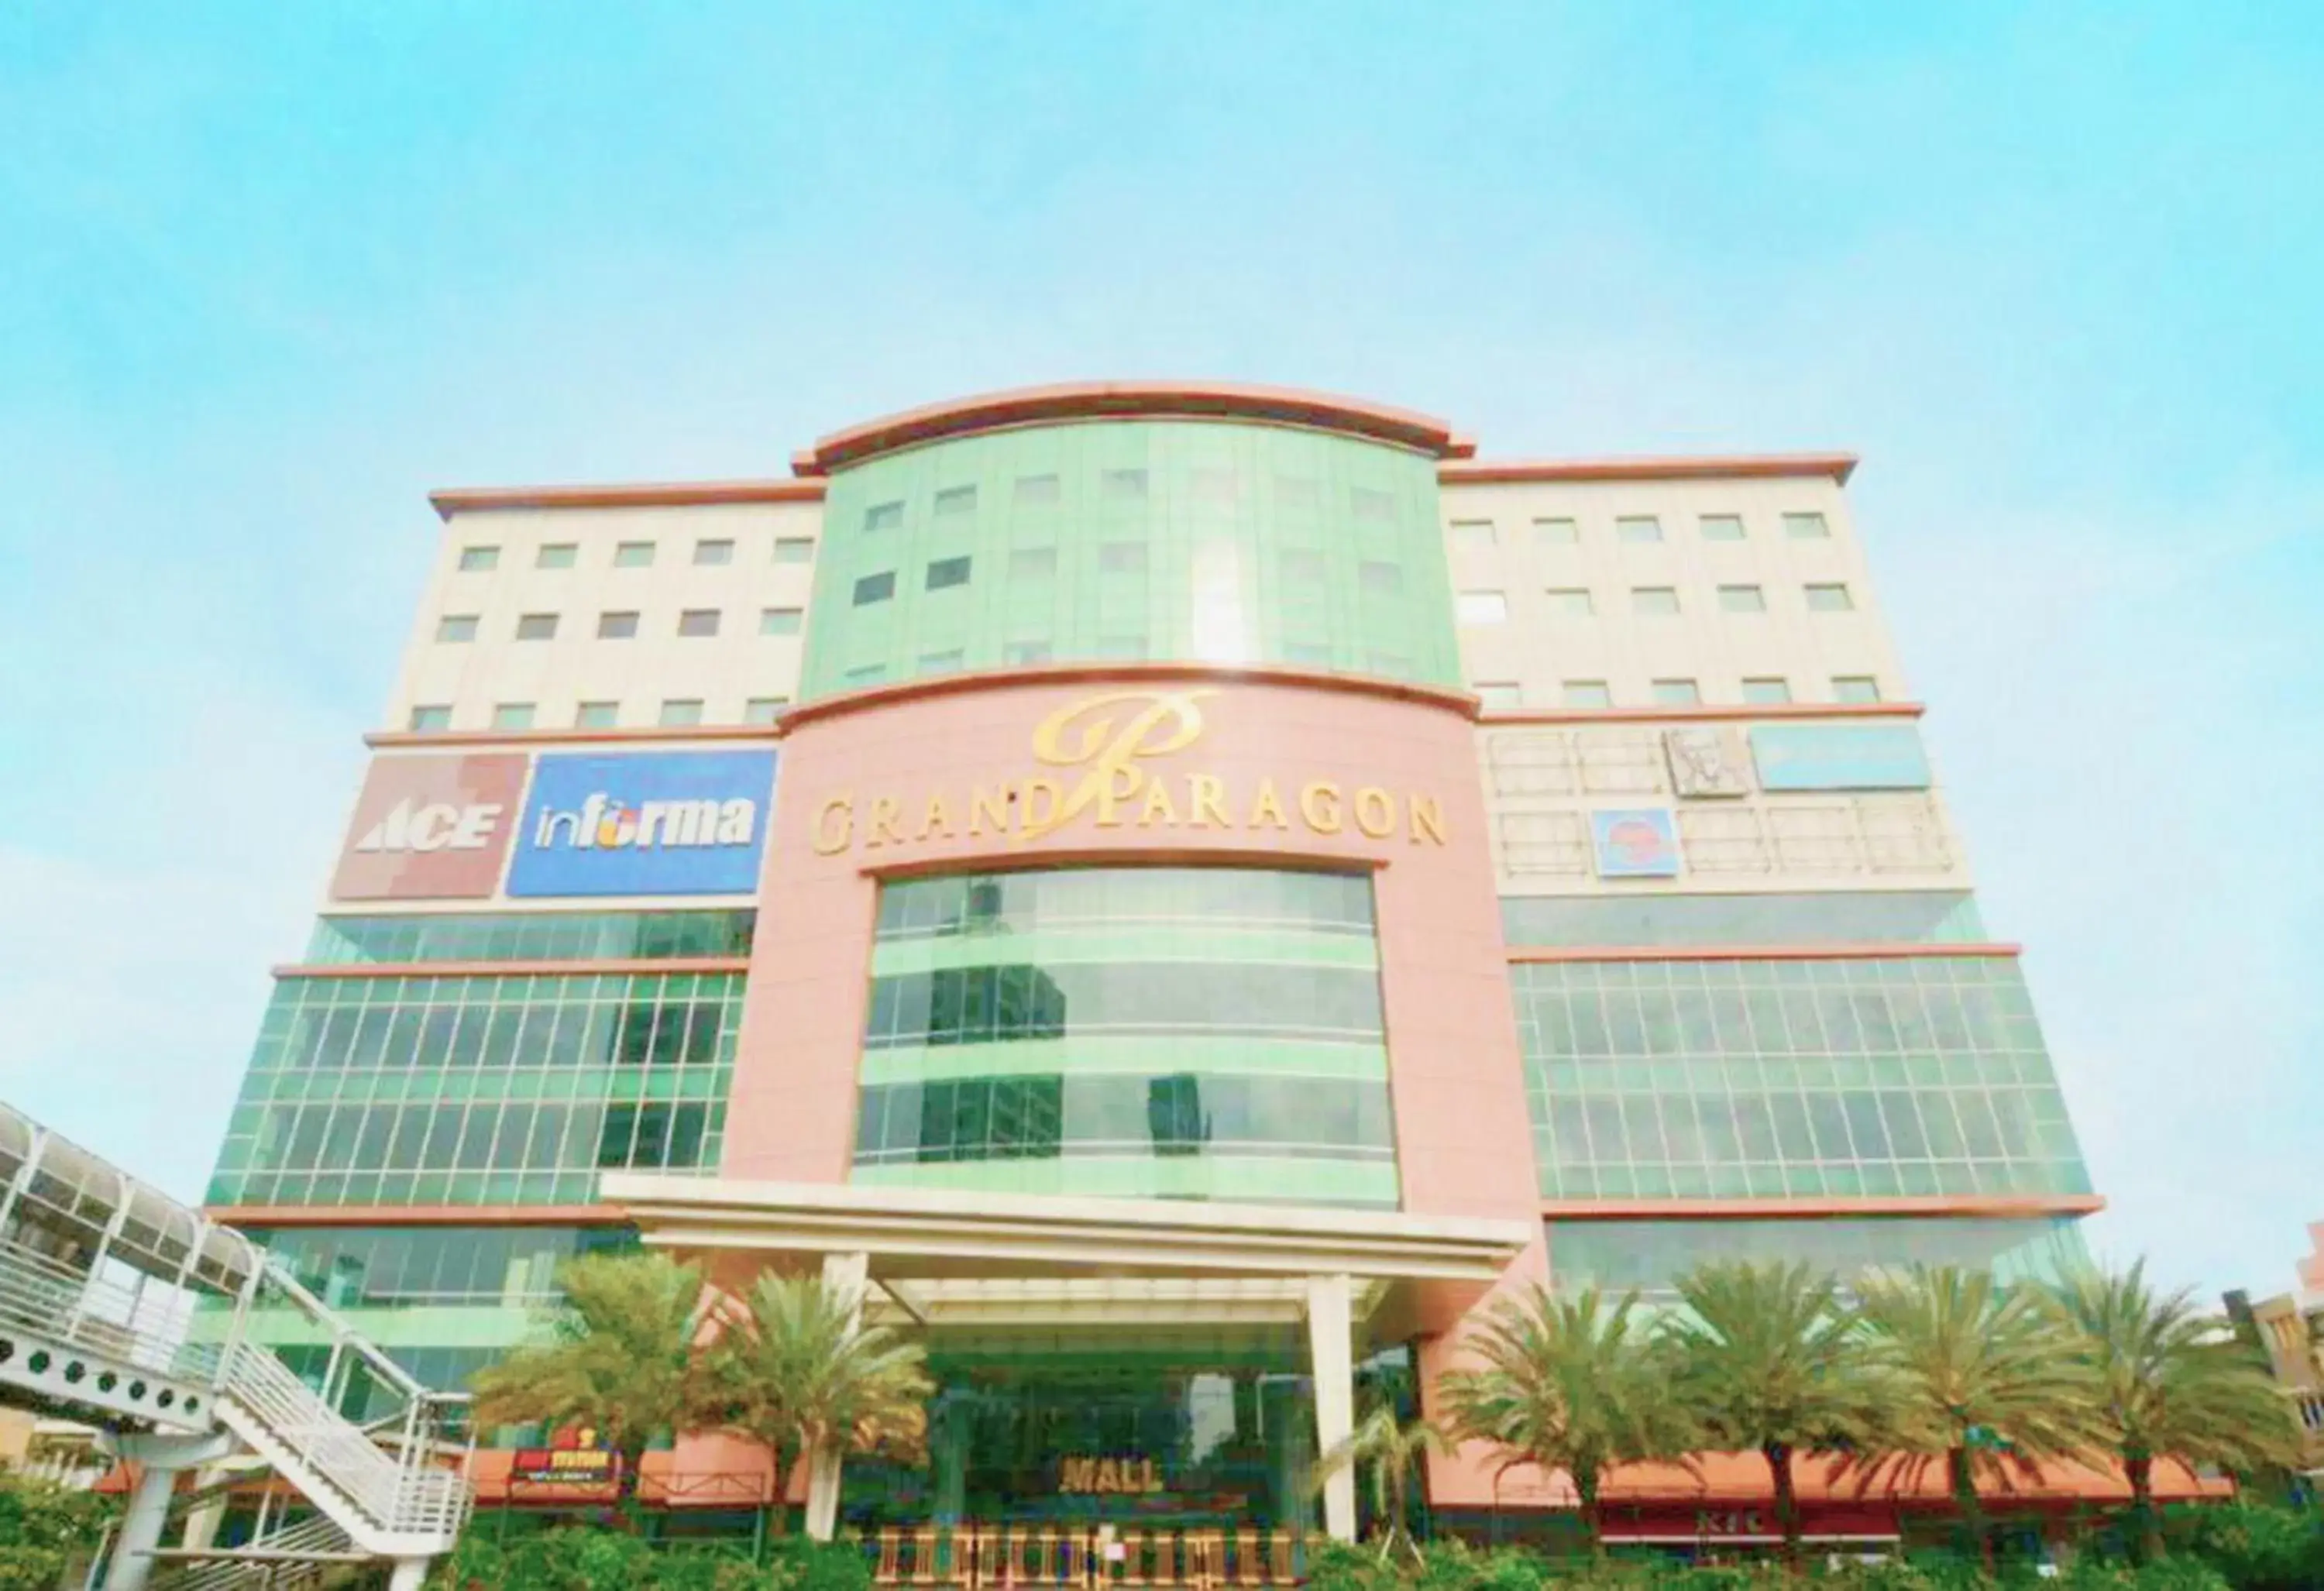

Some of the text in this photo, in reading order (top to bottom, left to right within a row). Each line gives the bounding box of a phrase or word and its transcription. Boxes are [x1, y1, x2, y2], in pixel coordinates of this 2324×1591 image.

[354, 796, 504, 852] ACE
[534, 791, 755, 850] informa
[810, 761, 1446, 857] GRAND PARAGON
[1057, 1456, 1164, 1493] MALL
